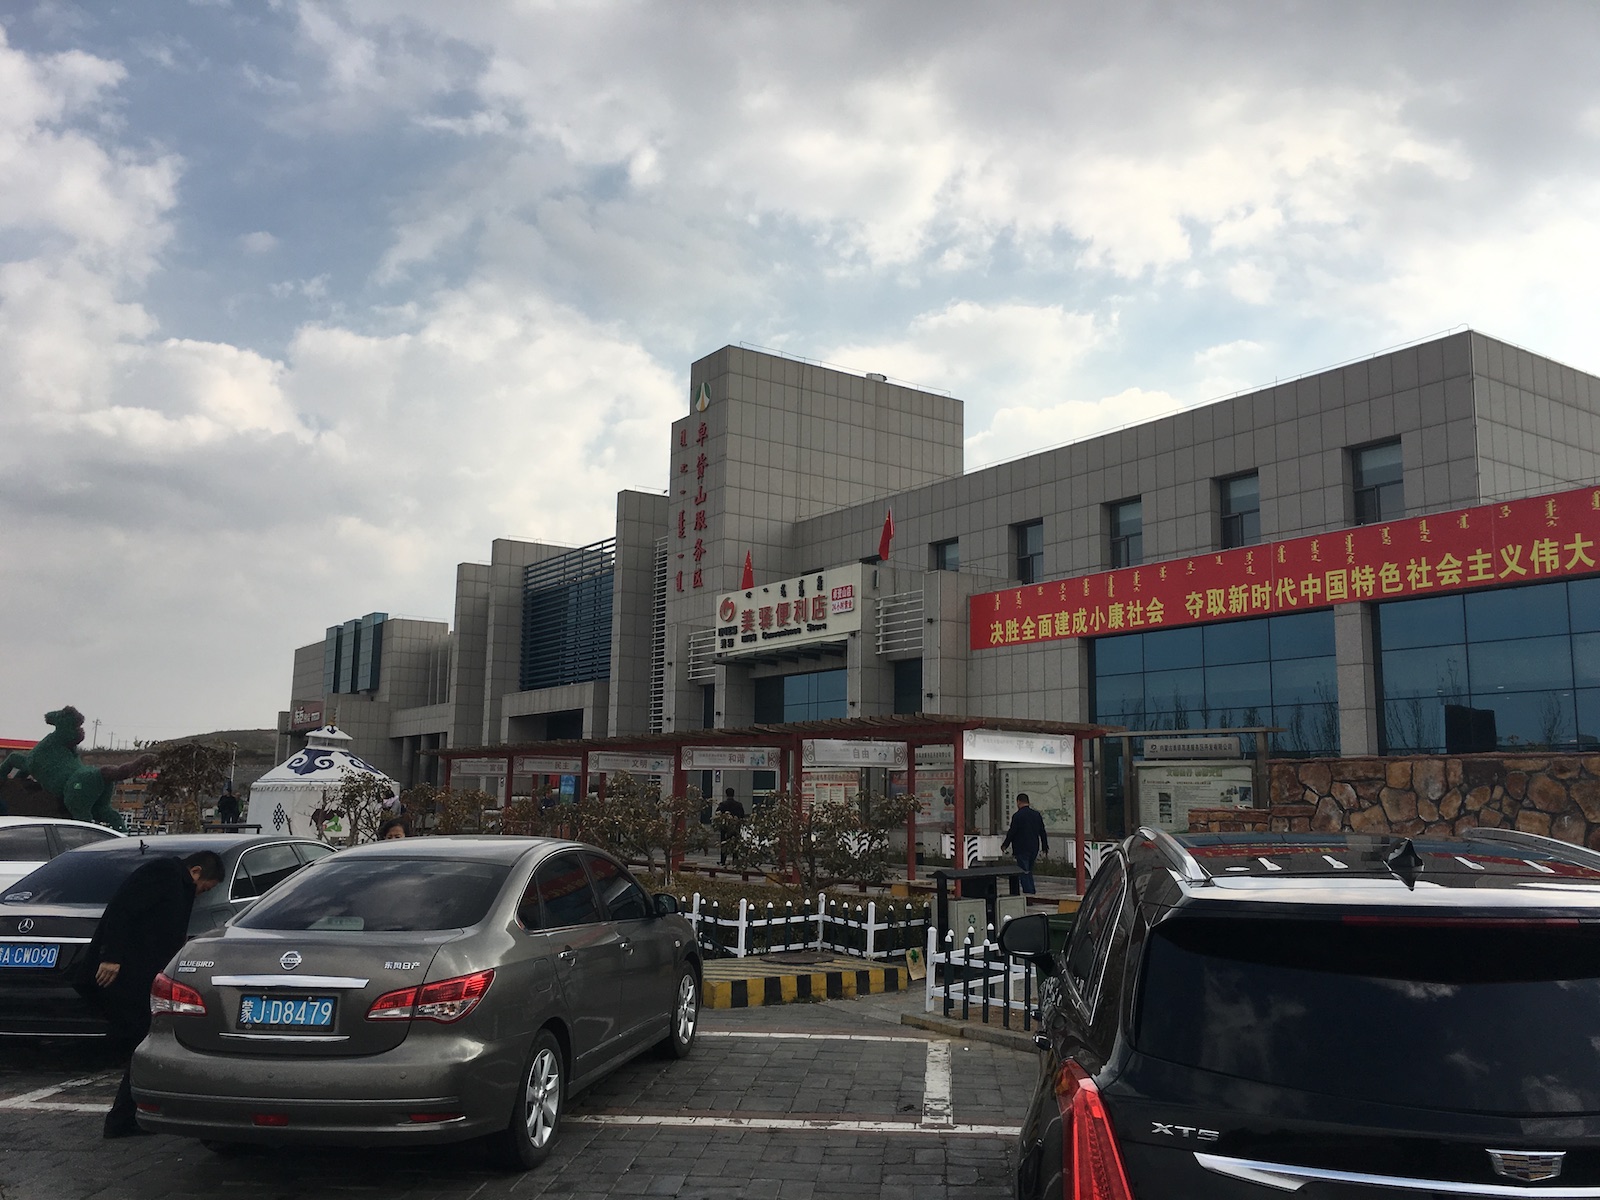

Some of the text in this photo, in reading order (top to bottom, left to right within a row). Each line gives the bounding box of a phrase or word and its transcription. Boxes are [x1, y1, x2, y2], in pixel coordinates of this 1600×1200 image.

[989, 596, 1165, 645] 决胜全面建成小康社会
[1185, 533, 1595, 620] 夺取新时代中国特色社会主义伟大
[1016, 739, 1036, 752] 平等
[728, 753, 746, 764] 和谐
[852, 748, 870, 760] 自由
[554, 761, 570, 770] 民主
[631, 759, 648, 769] 文明
[179, 960, 215, 968] BLUEBIRD
[384, 961, 421, 969] 东风日产
[1151, 1121, 1220, 1141] XT5
